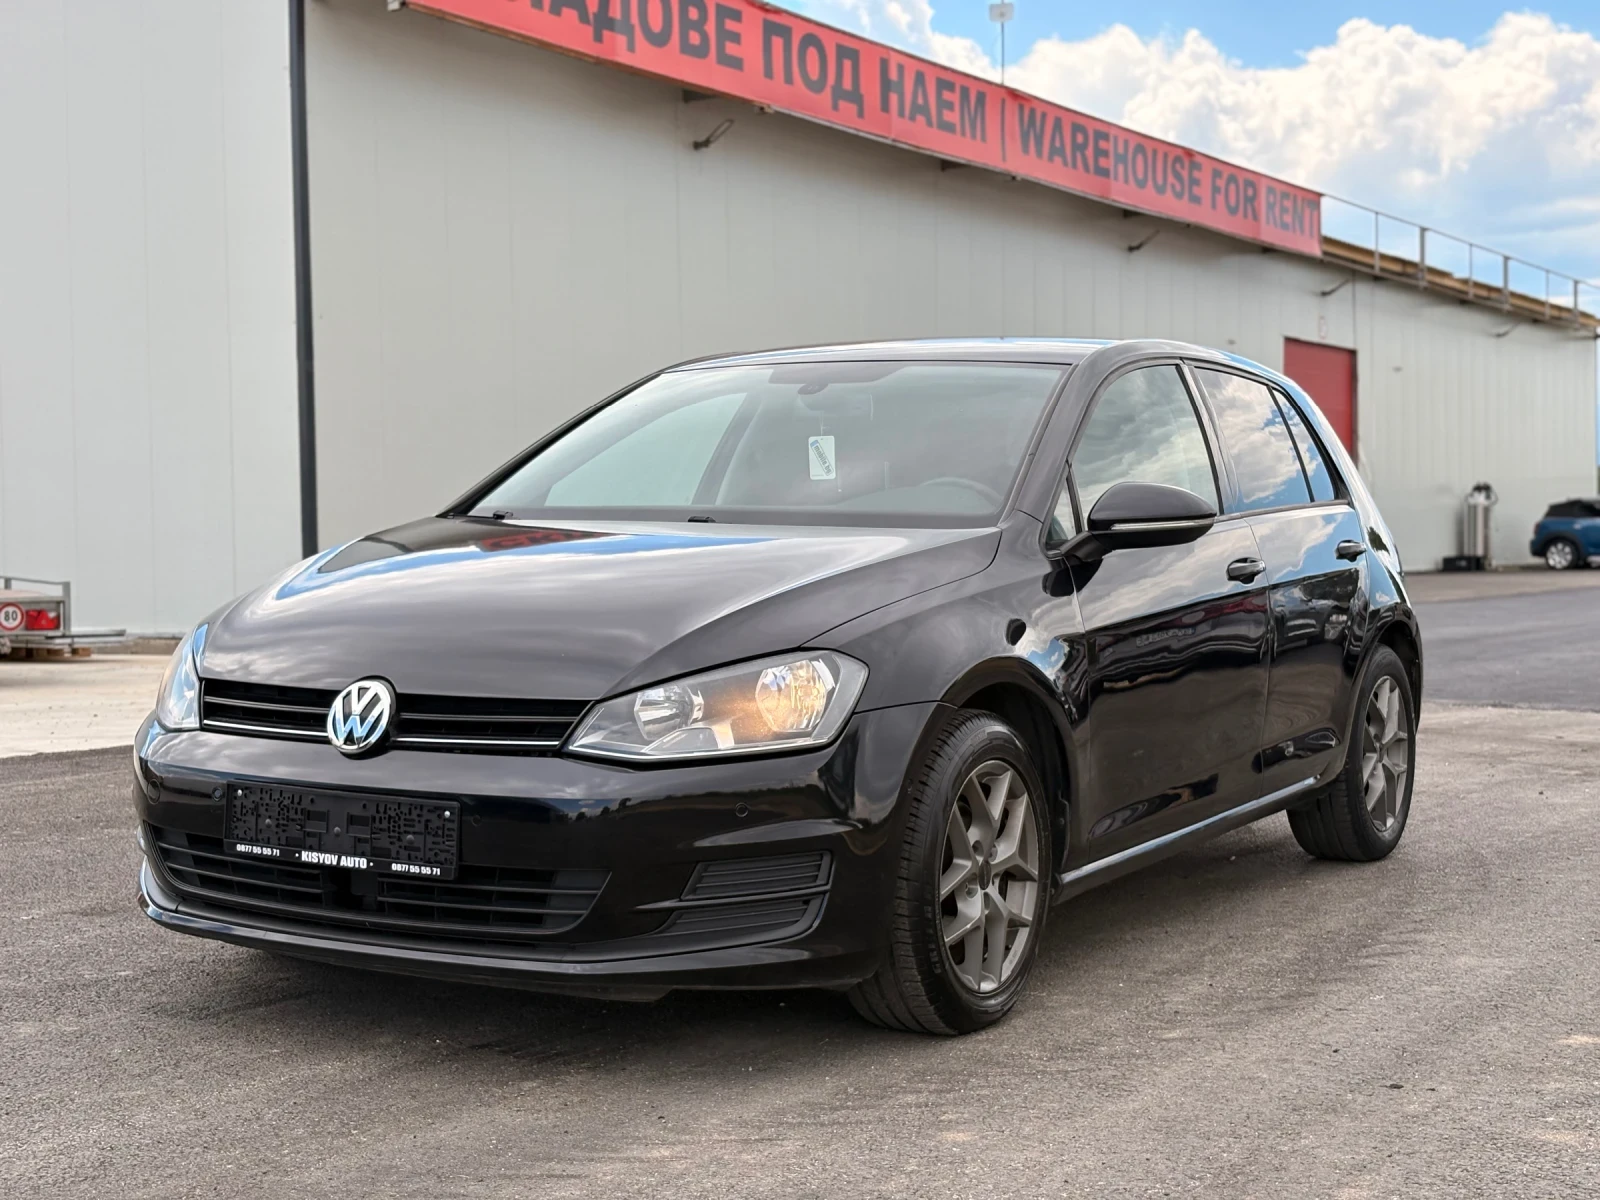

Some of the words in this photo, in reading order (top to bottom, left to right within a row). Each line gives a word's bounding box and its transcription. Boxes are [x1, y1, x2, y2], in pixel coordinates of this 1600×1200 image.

[529, 0, 744, 72] ДОВЕ
[762, 18, 865, 119] ПОД
[879, 57, 988, 143] НАЕМ
[1018, 103, 1203, 206] WAREHOUSE
[1211, 168, 1259, 222] FOR
[1265, 185, 1319, 239] RENT
[4, 610, 18, 622] 80
[333, 682, 389, 747] VW
[236, 843, 252, 853] 0877
[252, 845, 262, 855] 55
[262, 847, 272, 856] 55
[272, 848, 280, 857] 71
[301, 850, 339, 866] KISYOV
[339, 855, 368, 869] AUTO
[391, 862, 409, 872] 0877
[409, 864, 420, 874] 55
[420, 866, 431, 875] 55
[432, 867, 441, 876] 71
